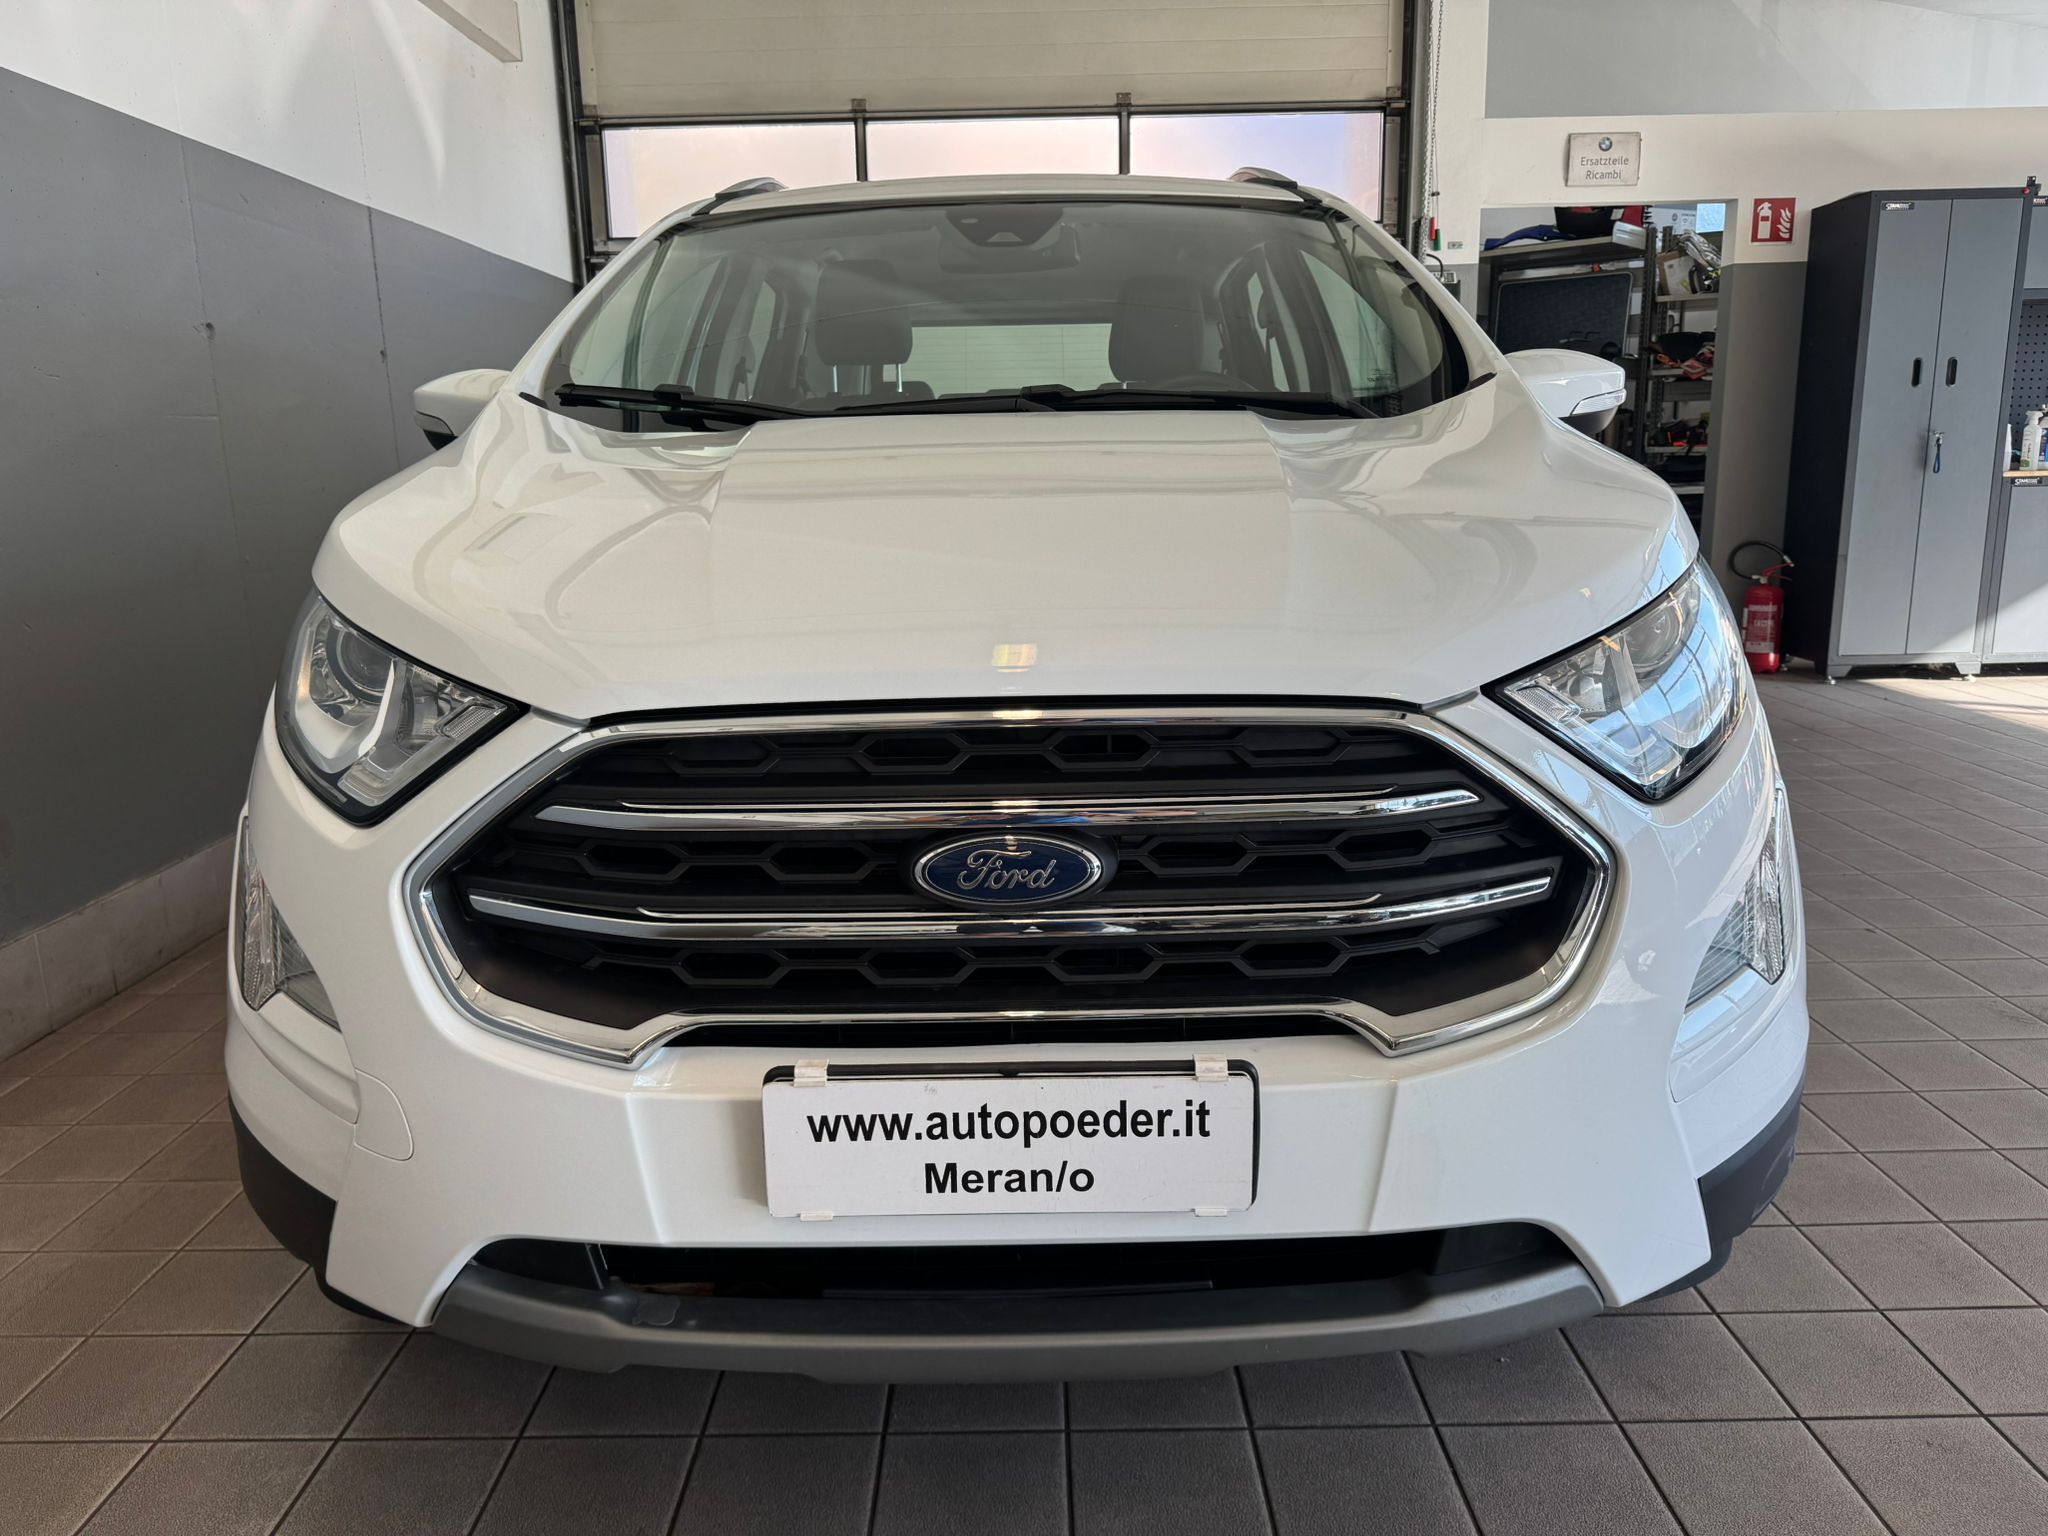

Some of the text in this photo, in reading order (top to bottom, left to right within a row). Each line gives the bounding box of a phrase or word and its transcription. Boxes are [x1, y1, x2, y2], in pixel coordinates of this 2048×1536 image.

[1580, 155, 1629, 166] Ersatzteile
[1585, 169, 1622, 180] Ricambi
[956, 849, 1057, 890] Ford
[806, 1099, 1211, 1149] www.autopoeder.it
[924, 1160, 1095, 1194] Meran/o
